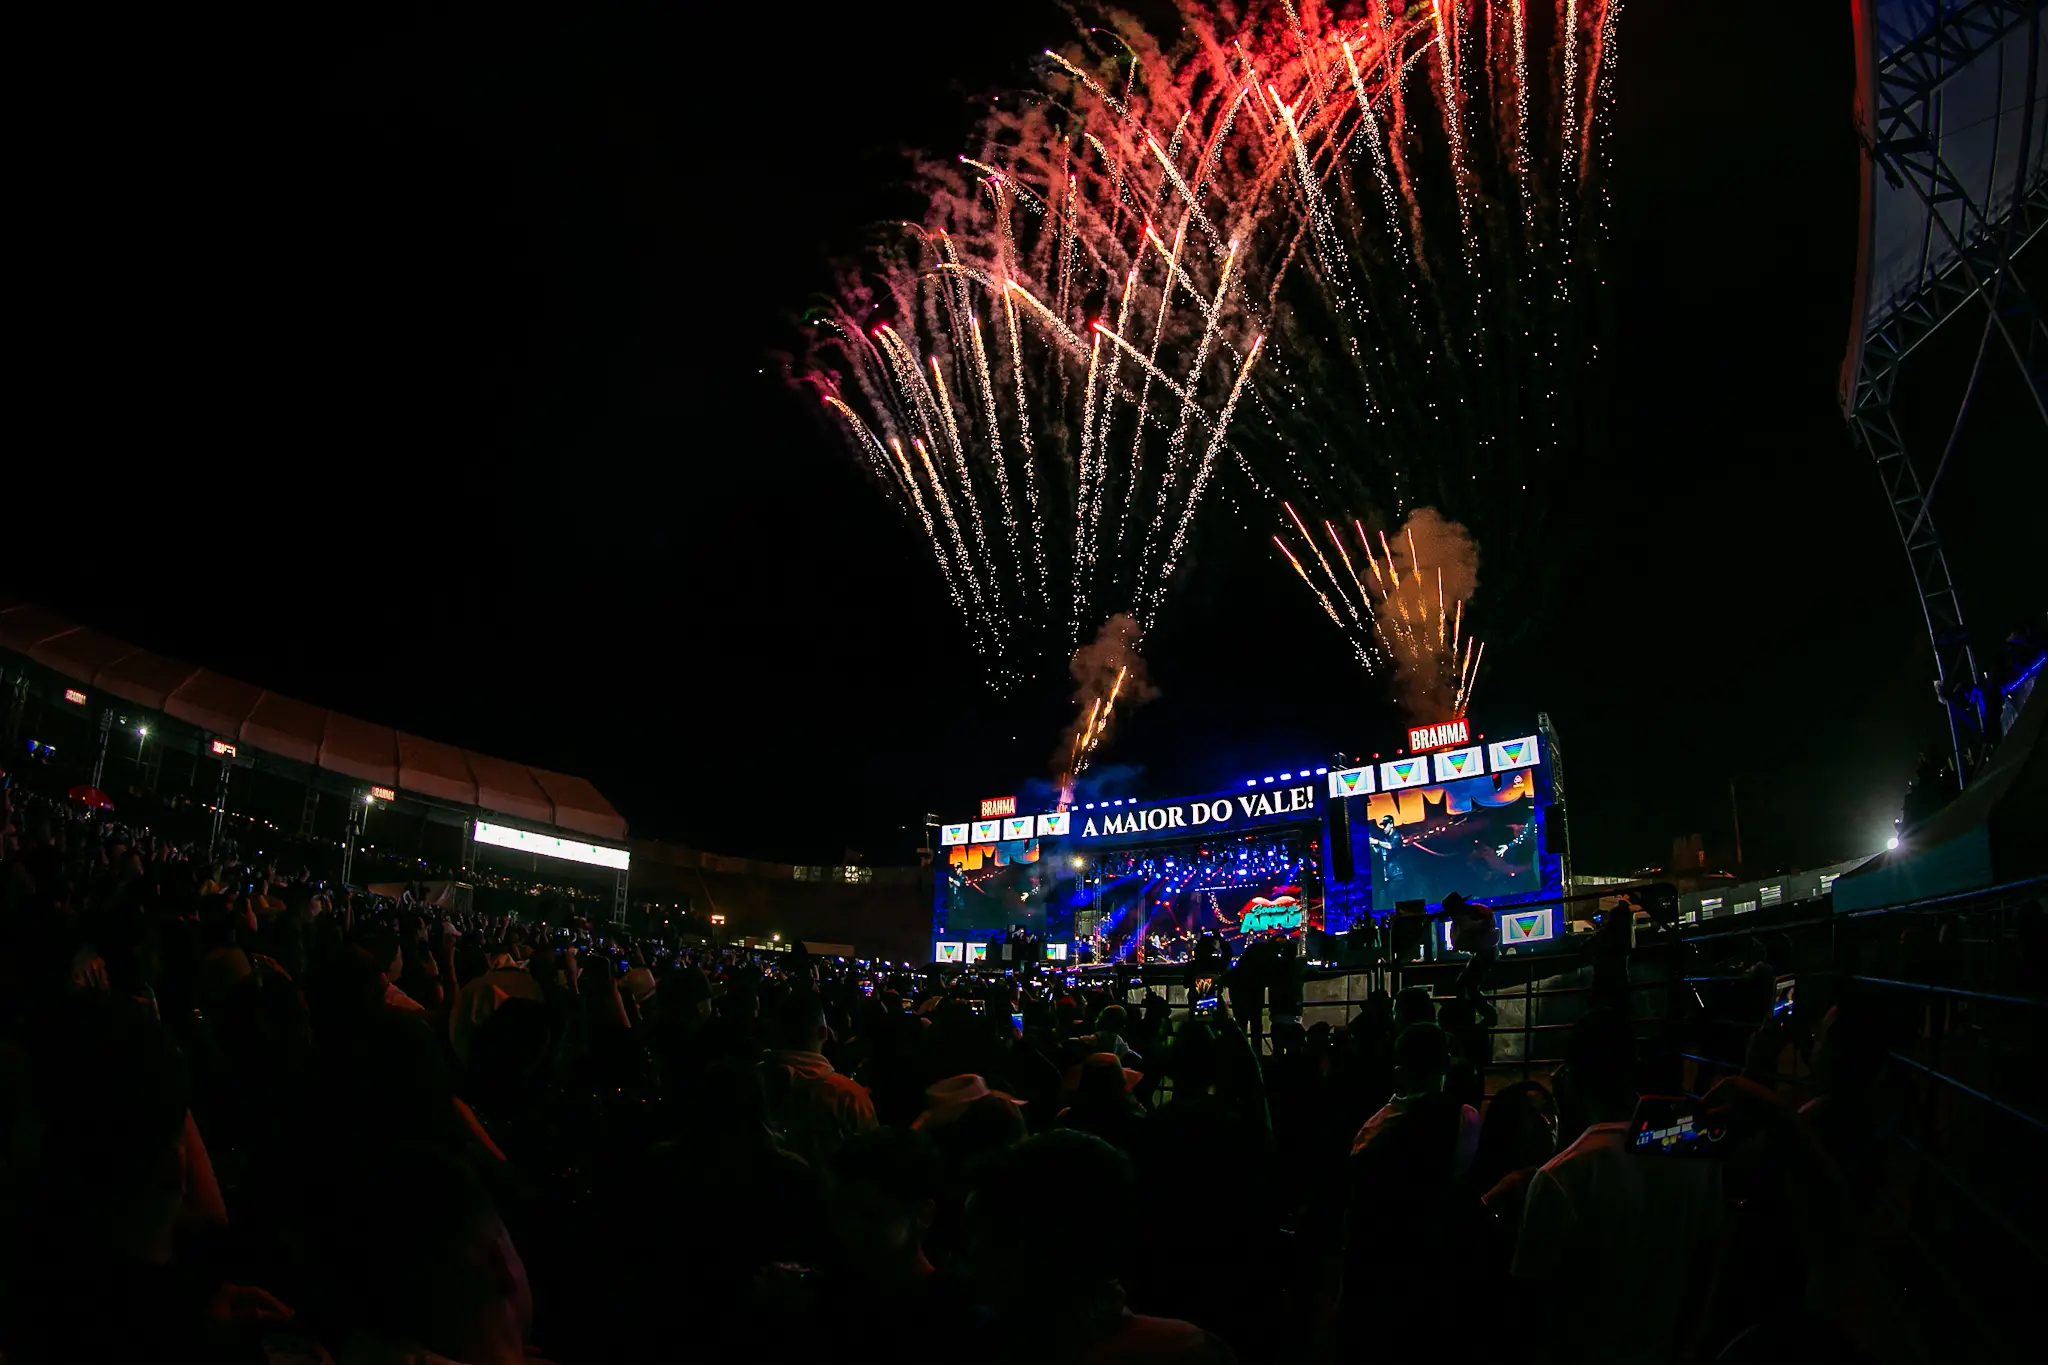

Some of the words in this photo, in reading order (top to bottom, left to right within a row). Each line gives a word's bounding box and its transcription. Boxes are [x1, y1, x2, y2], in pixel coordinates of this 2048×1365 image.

[1411, 722, 1469, 750] BRAHMA
[981, 798, 1016, 816] BRAHMA
[1081, 816, 1099, 838] A
[1102, 806, 1188, 836] MAIOR
[1191, 797, 1233, 826] DO
[1238, 785, 1315, 818] VALE!
